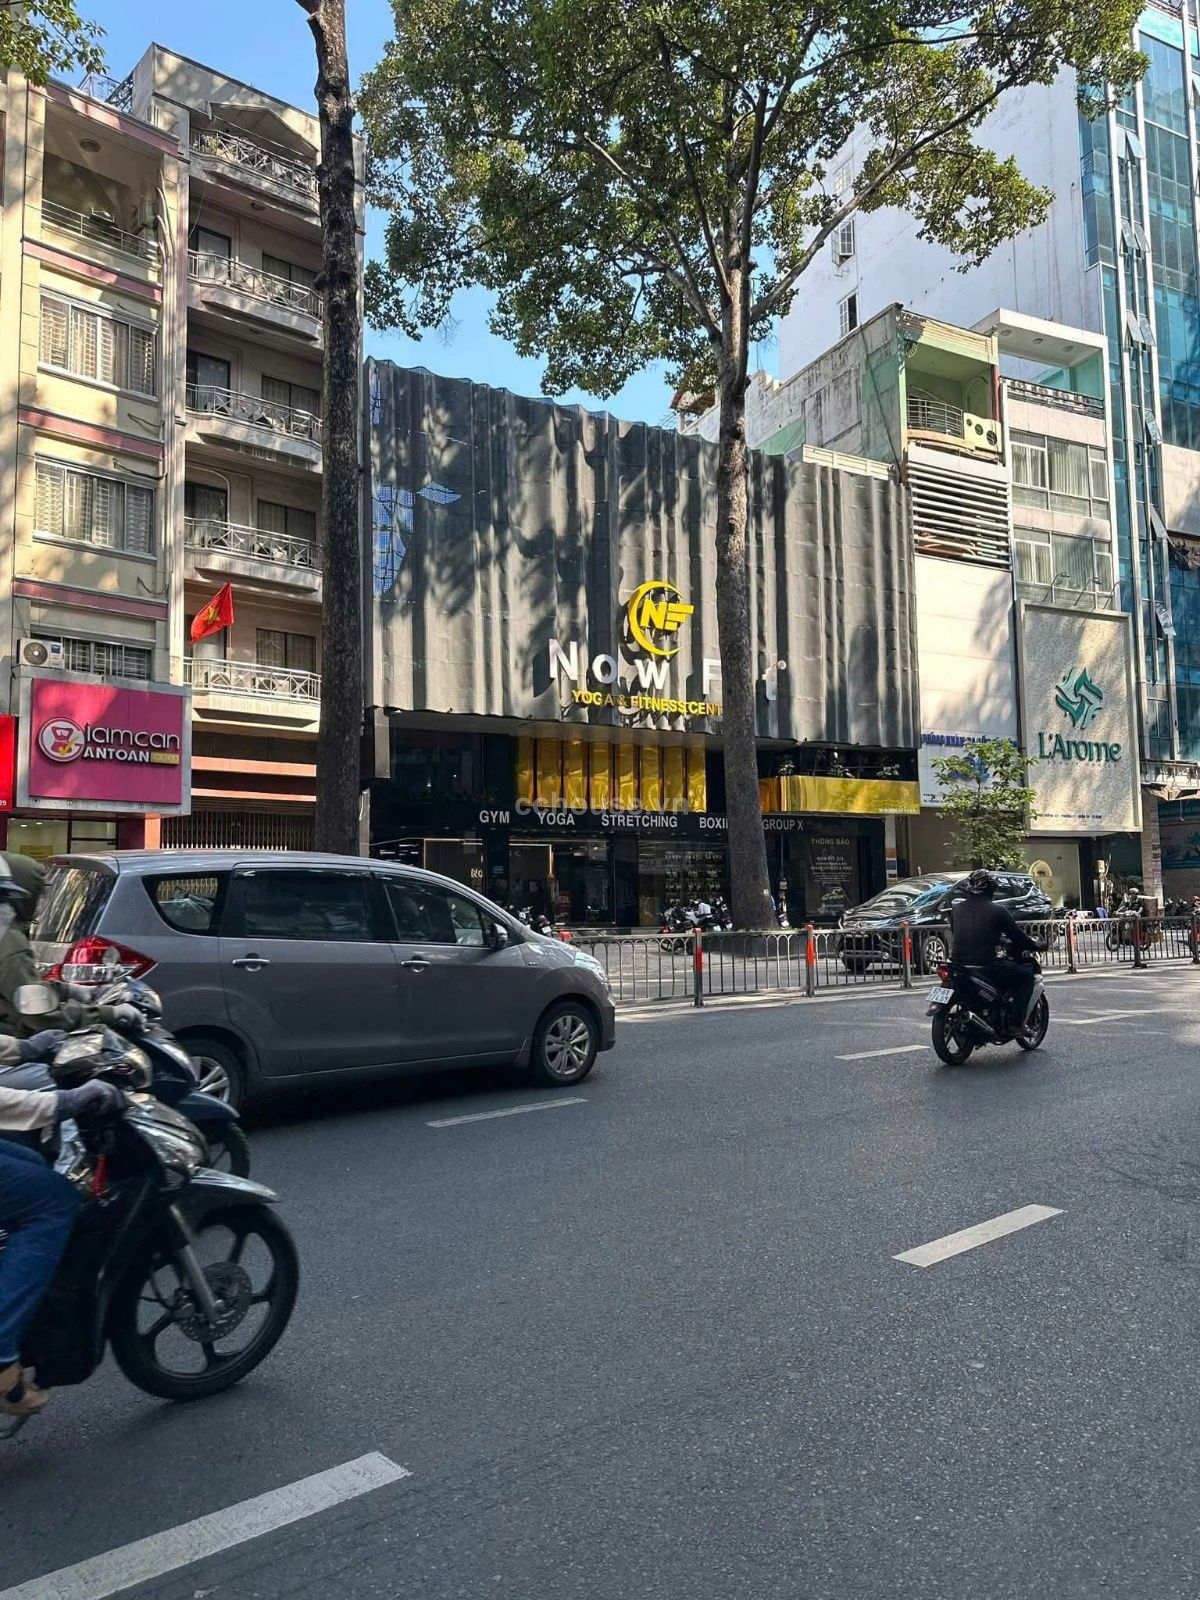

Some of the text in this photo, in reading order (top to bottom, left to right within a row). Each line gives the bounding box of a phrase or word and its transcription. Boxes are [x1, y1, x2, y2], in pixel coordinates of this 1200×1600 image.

[572, 690, 614, 706] YOGA
[619, 694, 627, 706] &
[631, 695, 686, 714] FITNESS
[83, 746, 150, 763] ANTOAN
[1038, 732, 1122, 763] L'Arome
[479, 810, 510, 824] GYM
[538, 812, 575, 826] YOGA
[601, 814, 678, 828] STRETCHING
[762, 819, 795, 831] GROUP
[797, 819, 804, 831] X
